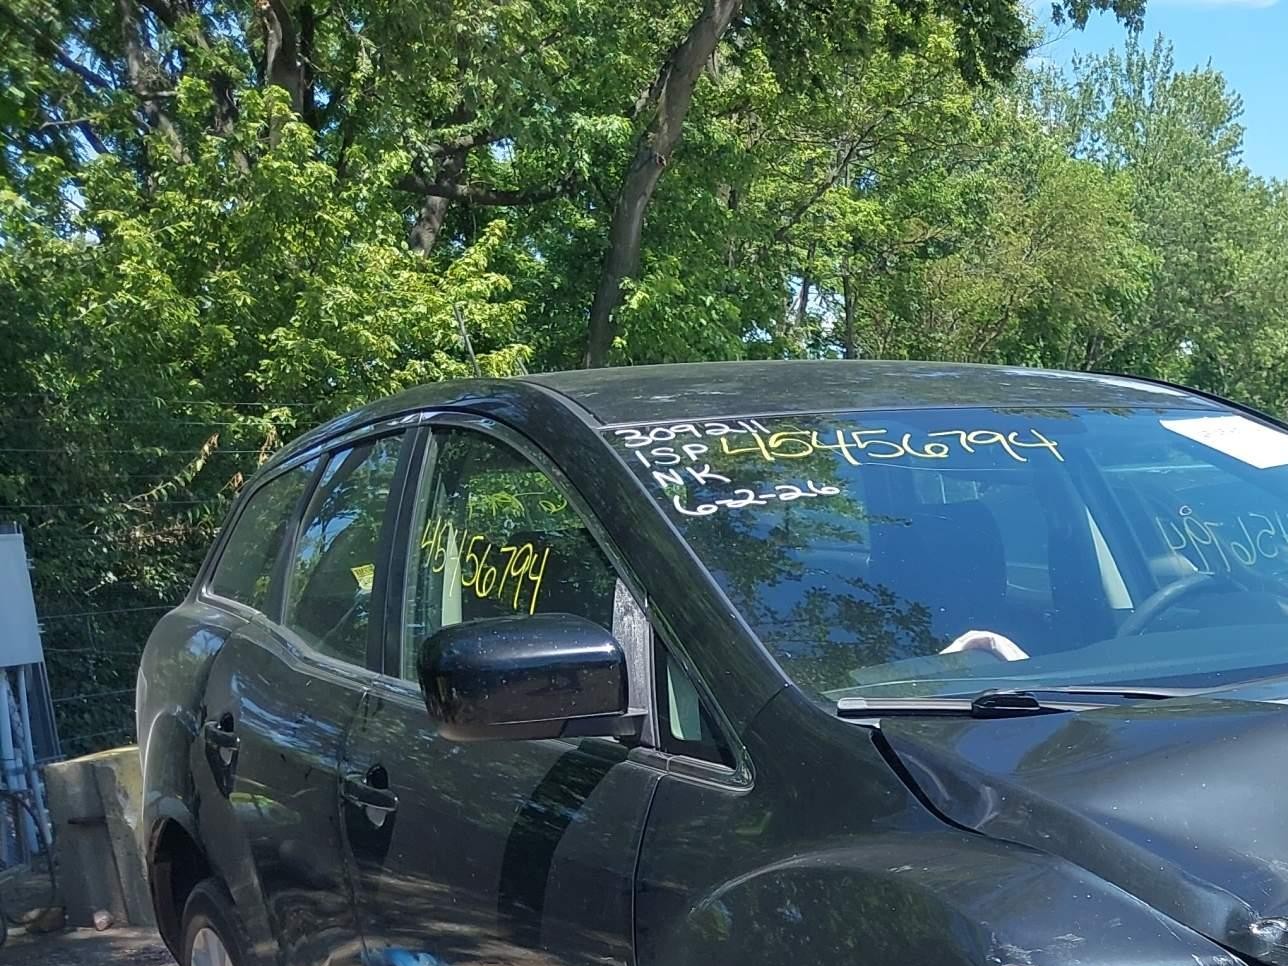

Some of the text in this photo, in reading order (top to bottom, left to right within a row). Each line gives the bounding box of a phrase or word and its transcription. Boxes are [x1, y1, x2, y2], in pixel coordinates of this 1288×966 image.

[615, 419, 770, 448] 309211
[720, 428, 1065, 466] 45456794
[421, 515, 550, 615] 45456794
